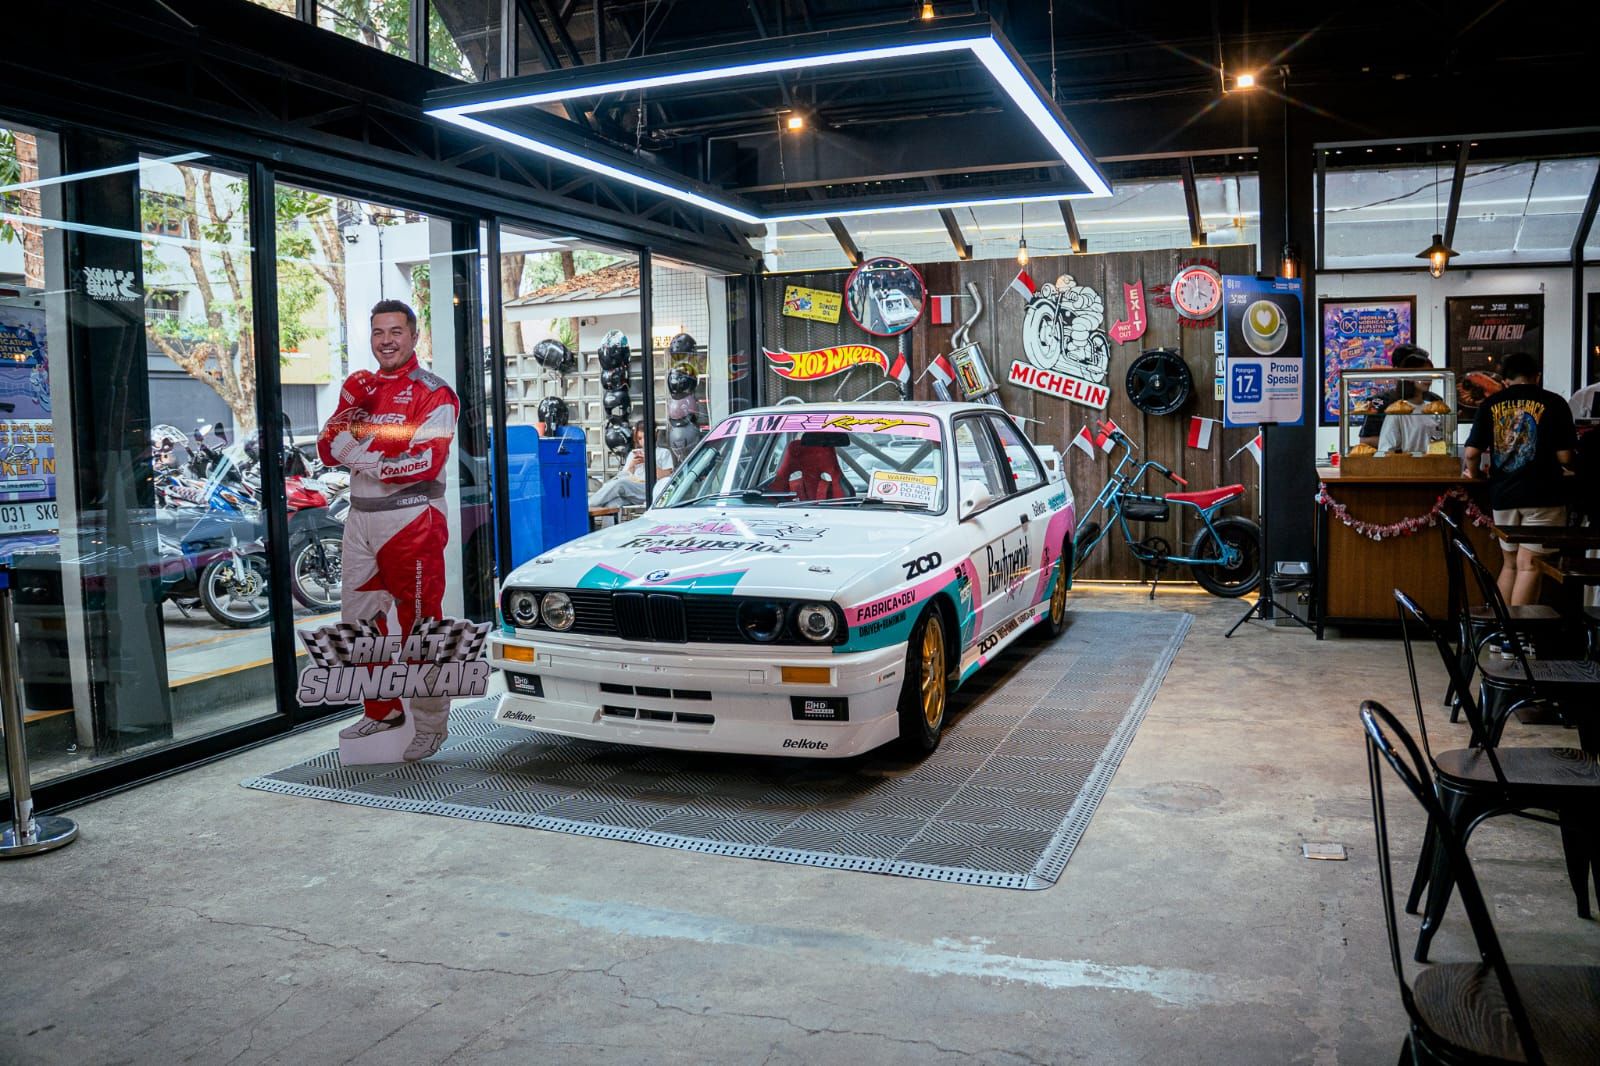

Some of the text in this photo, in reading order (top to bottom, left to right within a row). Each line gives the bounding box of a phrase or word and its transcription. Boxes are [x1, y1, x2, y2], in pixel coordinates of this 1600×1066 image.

[1130, 288, 1142, 332] EXIT
[1117, 324, 1131, 332] WAY
[1119, 330, 1132, 338] OUT
[1468, 324, 1525, 340] RALLY MENU
[788, 351, 828, 377] HOT
[1270, 362, 1298, 373] Promo
[1011, 363, 1106, 406] MICHELIN
[1236, 375, 1254, 393] 17
[1267, 374, 1299, 386] Spesial
[381, 460, 428, 476] XPANDER
[887, 474, 925, 483] WARNING
[900, 483, 931, 492] PLEASE
[915, 488, 931, 496] NOT
[900, 492, 931, 501] TOUCH
[902, 552, 942, 580] ZCD
[351, 633, 446, 664] RIFAT
[977, 632, 998, 655] ZCD
[299, 661, 490, 702] SUNGKAR
[805, 701, 826, 709] RHD
[502, 710, 536, 723] Belkote
[782, 738, 828, 750] Belkote
